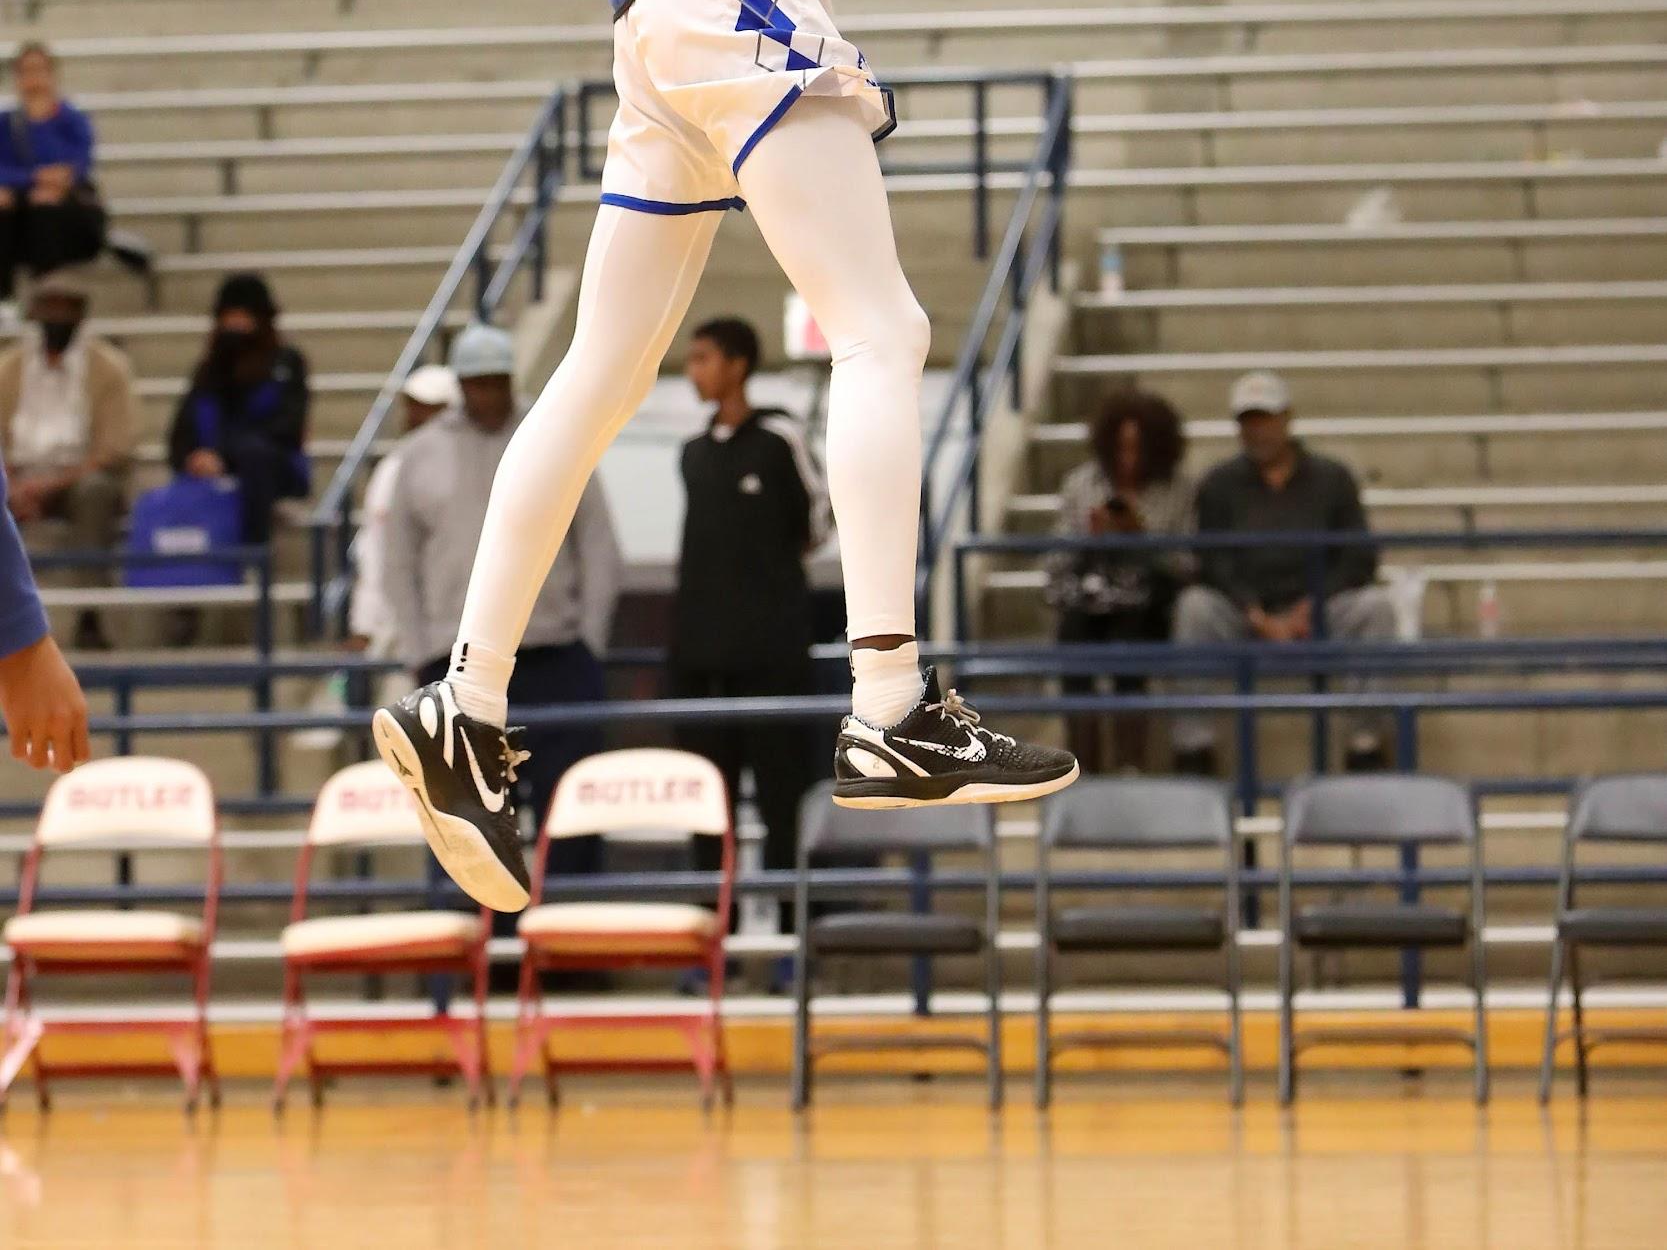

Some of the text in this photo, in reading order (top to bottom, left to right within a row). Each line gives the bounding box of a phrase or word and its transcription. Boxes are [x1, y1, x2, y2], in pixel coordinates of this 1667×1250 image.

[67, 783, 196, 811] BUTLER
[338, 785, 414, 813] BUT
[577, 777, 704, 805] BUTLER
